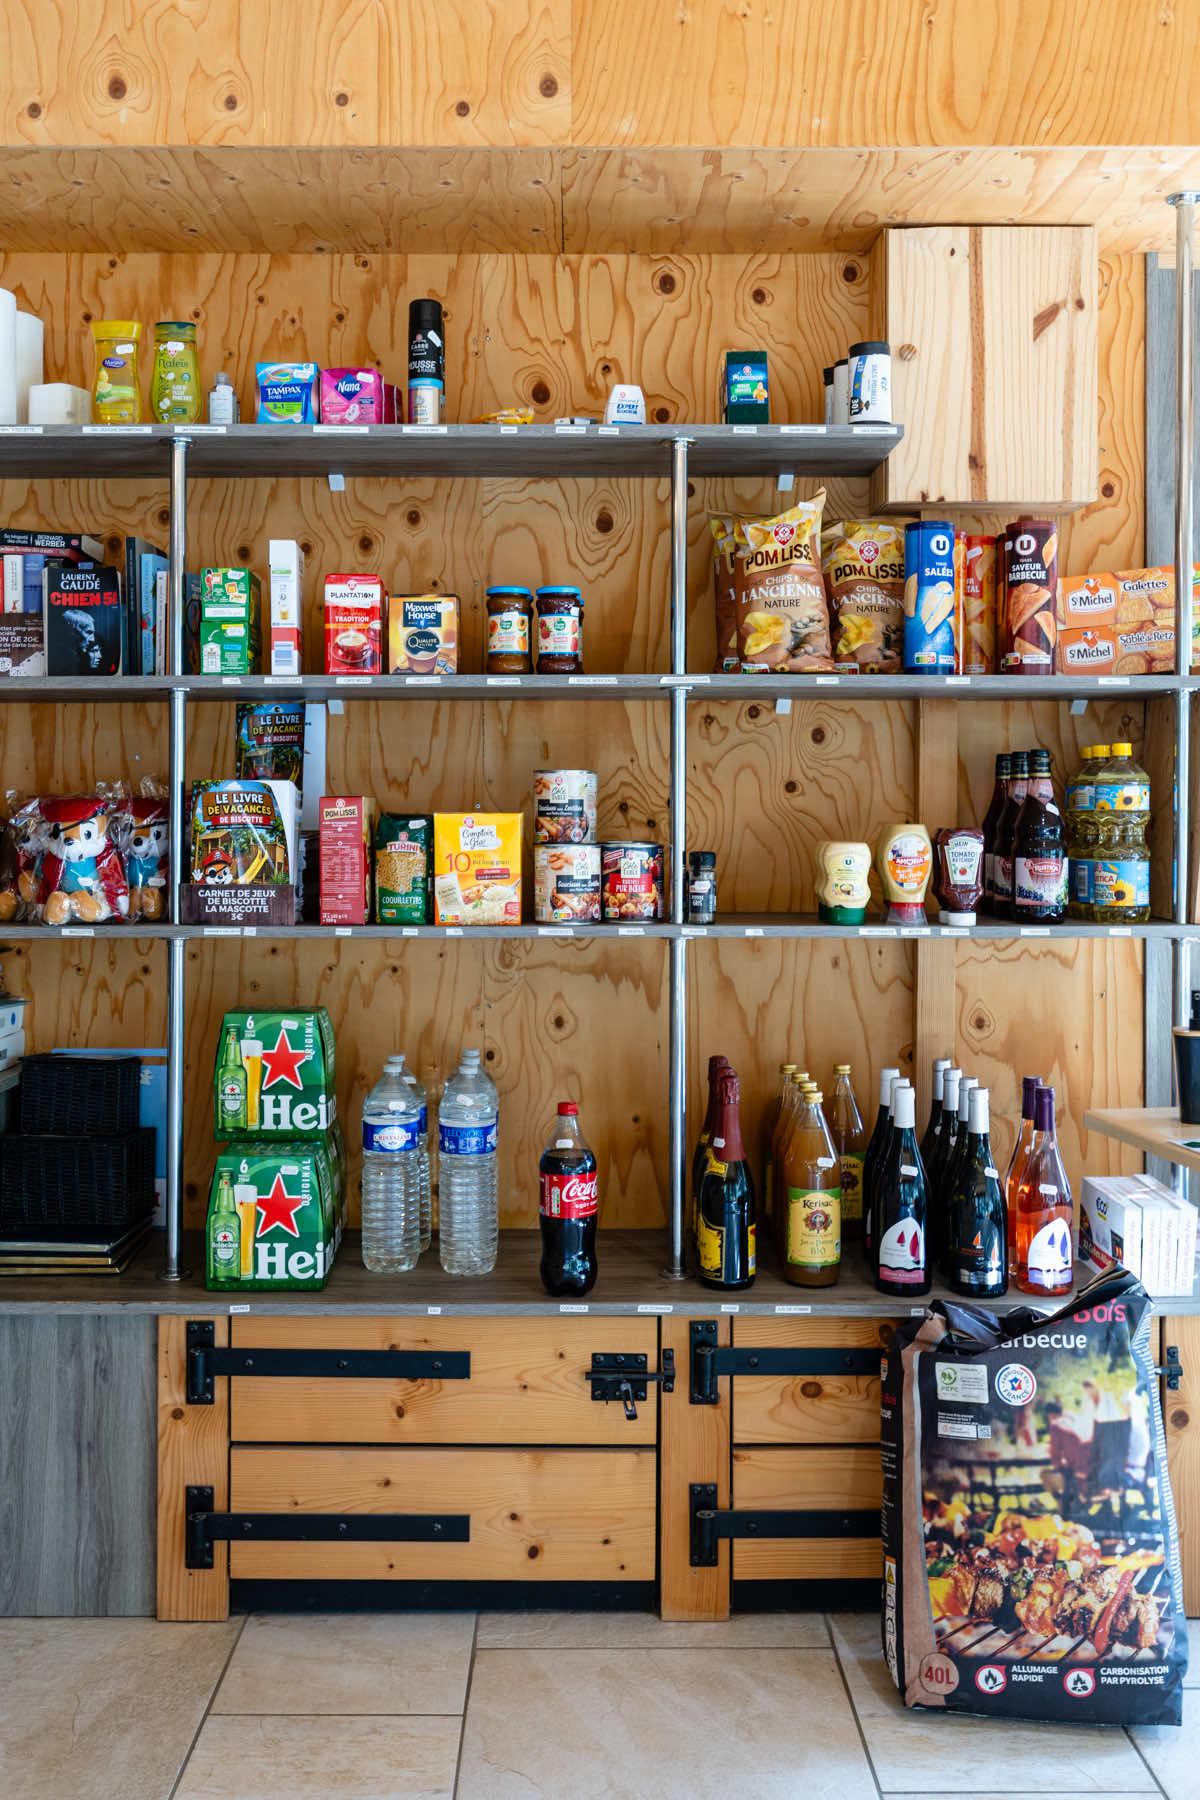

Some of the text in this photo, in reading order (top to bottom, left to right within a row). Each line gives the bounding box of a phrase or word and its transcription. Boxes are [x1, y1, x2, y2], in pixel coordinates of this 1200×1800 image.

[267, 385, 302, 397] TAMPAX
[337, 381, 361, 393] Nana
[850, 397, 860, 414] 30L
[34, 539, 66, 548] WERBER
[936, 540, 947, 552] U
[1020, 540, 1032, 553] U
[745, 550, 779, 570] POM
[834, 564, 866, 582] POM
[1012, 563, 1042, 571] SAVEUR
[1009, 570, 1047, 581] BARBECUE
[60, 578, 100, 590] GAUDÉ
[1123, 579, 1168, 591] Galettes
[50, 592, 118, 607] CHIEN 51
[764, 599, 800, 609] NATURE
[1079, 594, 1112, 607] Michel
[857, 605, 889, 614] NATURE
[408, 612, 437, 620] House
[1119, 633, 1145, 645] Sablé
[1153, 630, 1174, 642] Retz
[1077, 646, 1110, 658] Michel
[260, 714, 300, 726] LE LIVRE
[253, 726, 265, 736] DE
[215, 793, 264, 805] LE LIVRE
[207, 804, 272, 816] DE VACANCES
[324, 810, 338, 818] POM
[219, 815, 264, 824] DE BISCOTTE
[389, 844, 419, 852] TURINI
[445, 852, 471, 872] 10
[198, 889, 276, 898] CARNET DE JEUX
[222, 897, 267, 905] BISCOTTE
[219, 905, 269, 913] MASCOTTE
[231, 912, 243, 921] 3€
[246, 1015, 255, 1029] 6
[304, 1015, 316, 1060] ORIGINAL
[239, 1159, 249, 1173] 6
[301, 1158, 312, 1207] ORIGINAL
[802, 1199, 832, 1210] Kerisac
[1073, 1297, 1127, 1323] Bois
[990, 1334, 1088, 1350] arbecue
[1003, 1387, 1030, 1400] FRANCE
[1011, 1665, 1058, 1674] ALLUMAGE
[1100, 1665, 1169, 1676] CARBONISATION
[924, 1666, 955, 1686] 40L
[1011, 1674, 1044, 1683] RAPIDE
[1100, 1675, 1165, 1685] PAR PYROLYSE
